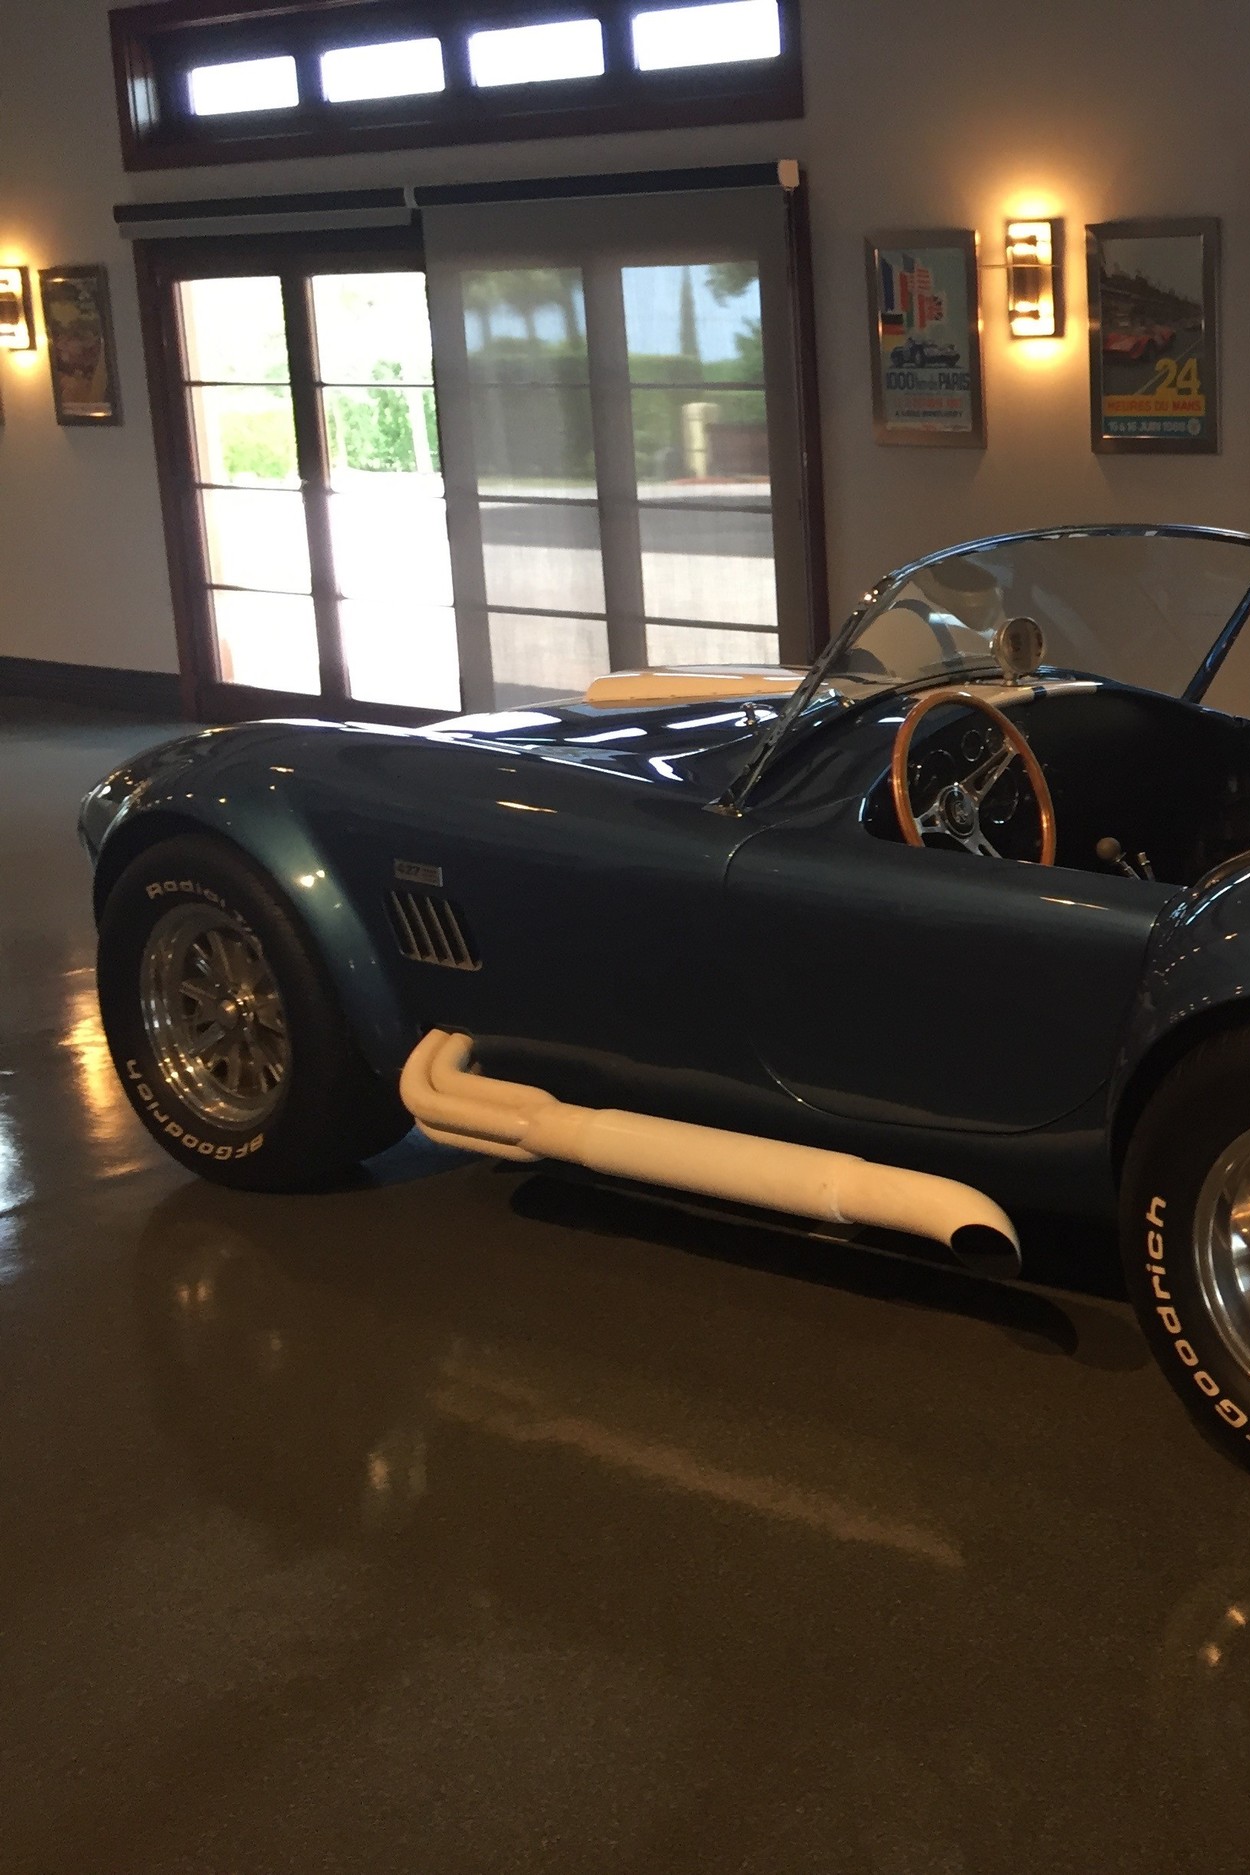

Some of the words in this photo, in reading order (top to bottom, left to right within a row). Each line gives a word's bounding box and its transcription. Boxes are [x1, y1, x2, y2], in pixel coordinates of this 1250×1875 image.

[886, 372, 914, 390] 1000
[1155, 357, 1201, 397] 24
[1107, 400, 1152, 412] HEURES
[1154, 400, 1168, 412] DU
[1172, 400, 1202, 412] MANS
[126, 1059, 264, 1160] BFGoodrich
